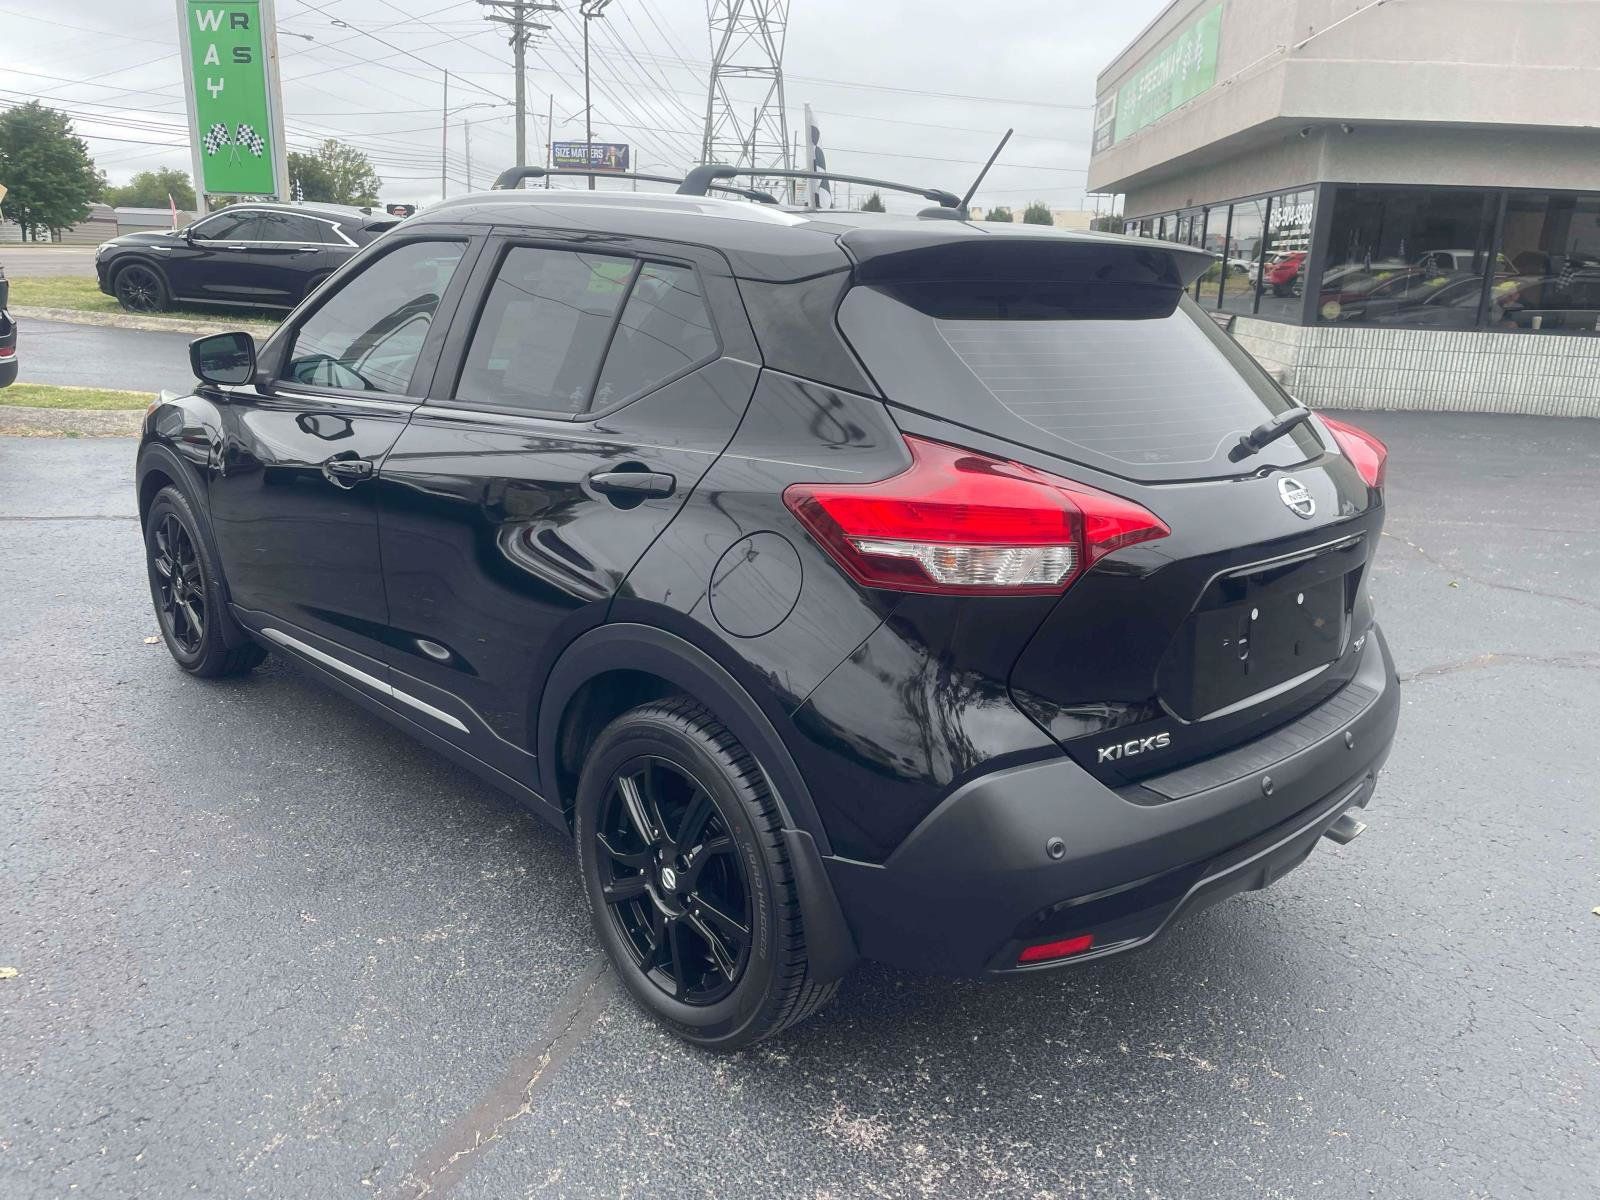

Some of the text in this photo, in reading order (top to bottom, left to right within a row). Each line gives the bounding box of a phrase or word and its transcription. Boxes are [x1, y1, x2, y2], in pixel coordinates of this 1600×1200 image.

[555, 147, 570, 158] SIZE
[1097, 732, 1171, 763] KICKS
[745, 842, 767, 960] ROAD HUGGER
